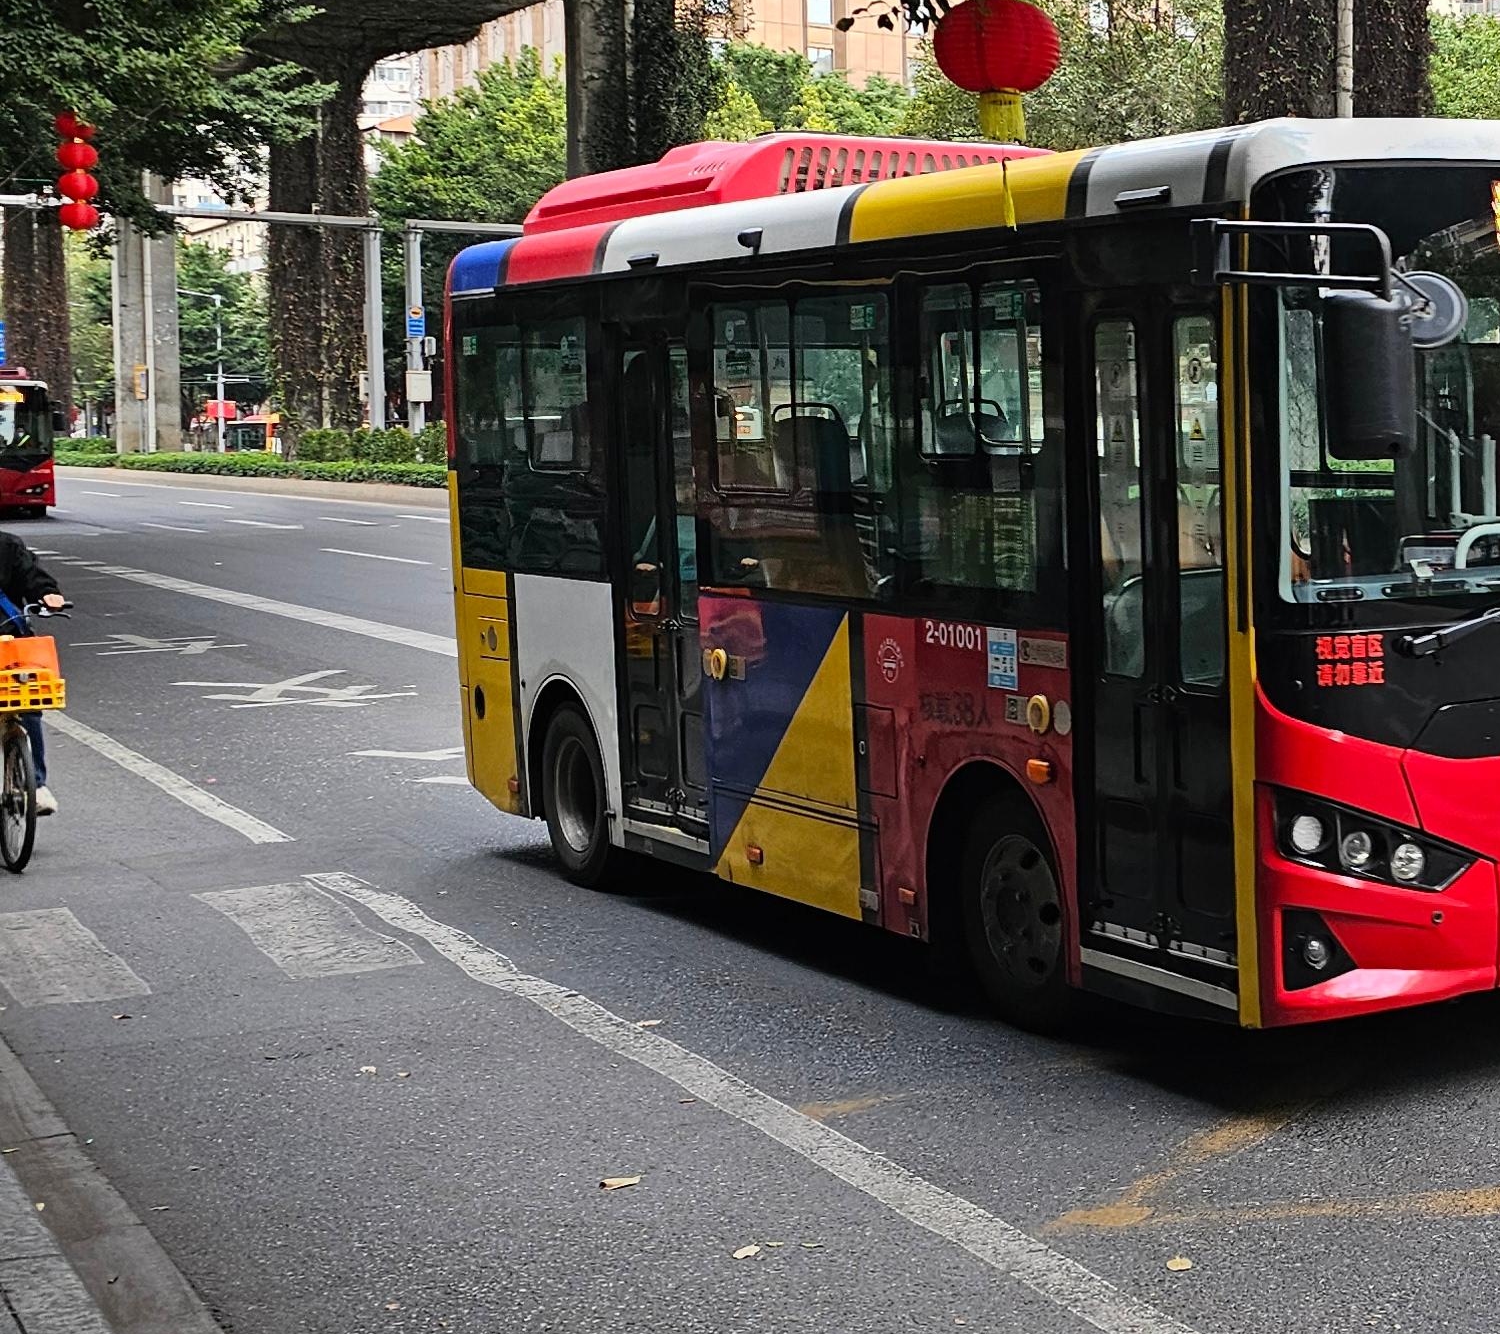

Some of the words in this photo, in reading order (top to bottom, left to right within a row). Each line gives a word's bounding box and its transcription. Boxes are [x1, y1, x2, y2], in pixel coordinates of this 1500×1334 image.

[926, 620, 982, 652] 2-01001
[1315, 634, 1384, 659] 视觉盲区
[1316, 661, 1385, 686] 请勿靠近
